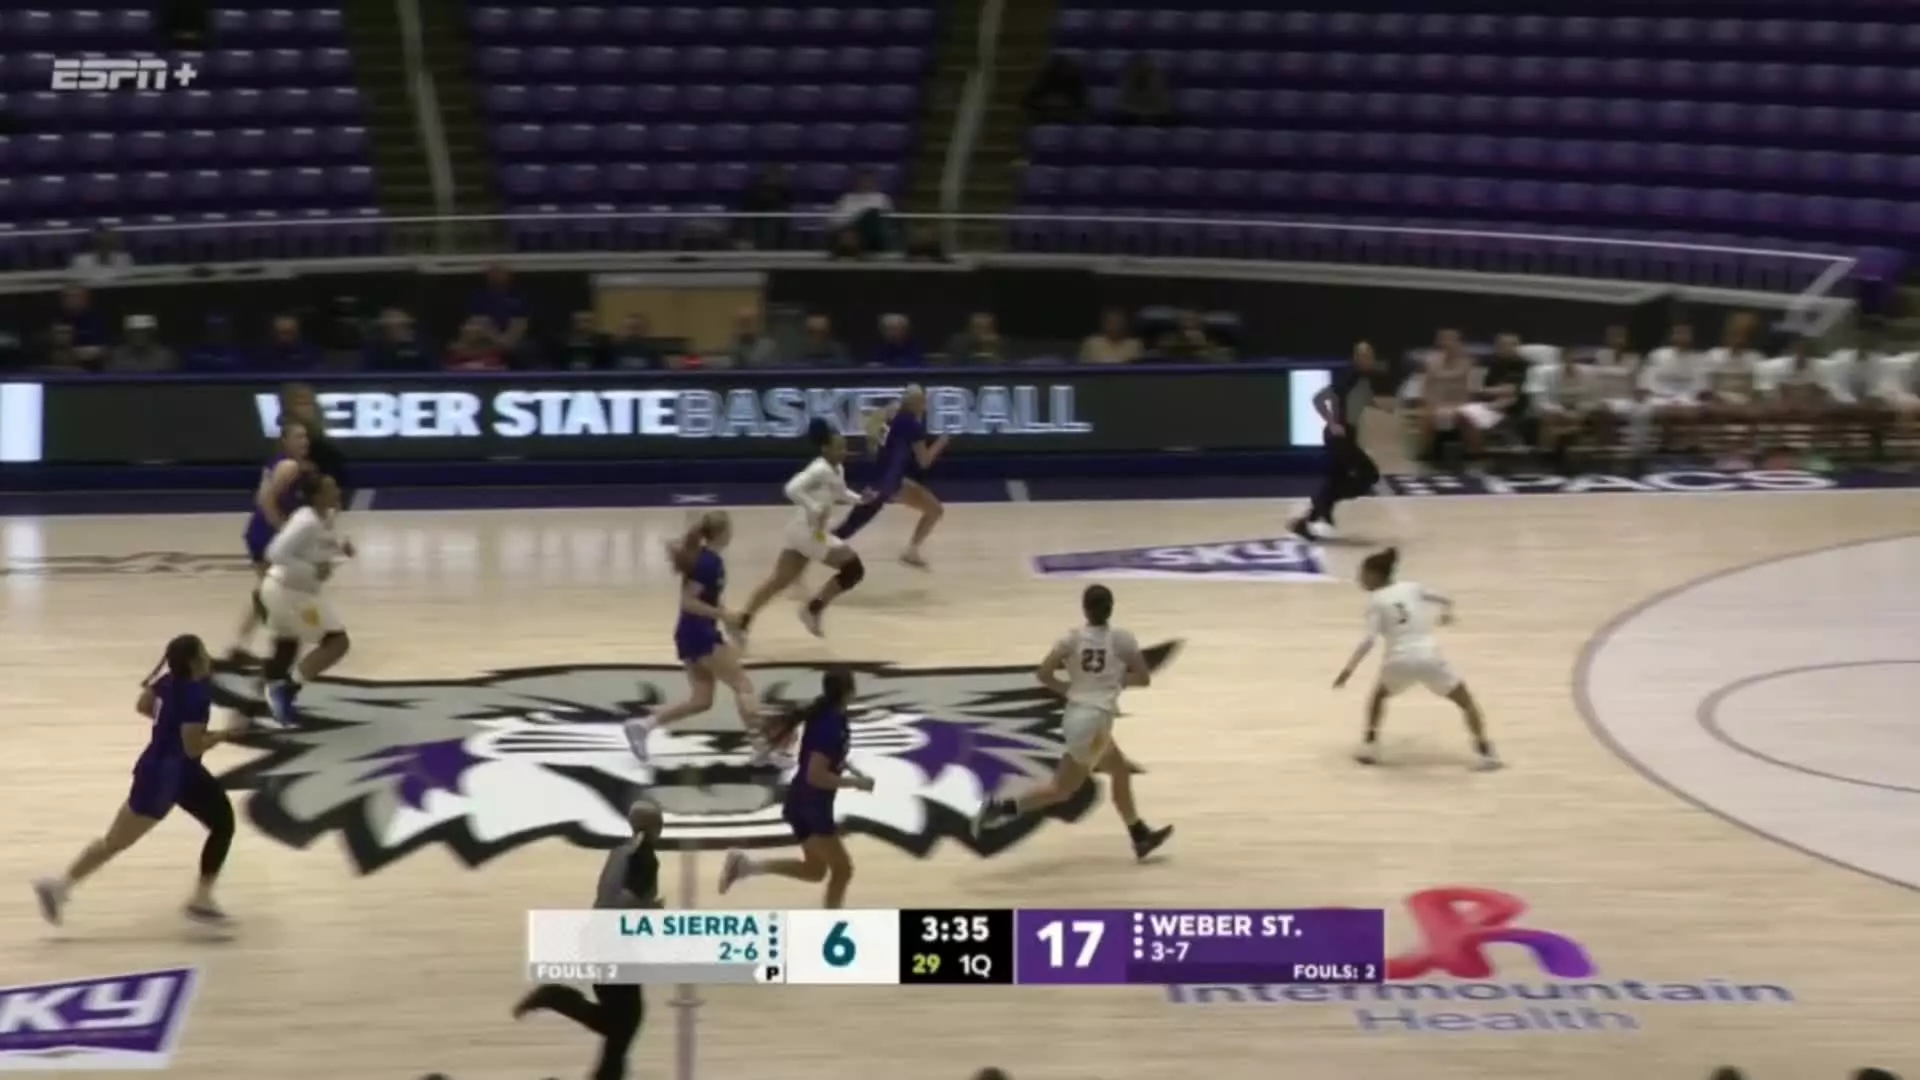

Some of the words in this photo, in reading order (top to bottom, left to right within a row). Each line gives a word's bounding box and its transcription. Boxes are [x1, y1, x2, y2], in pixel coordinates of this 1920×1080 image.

[492, 390, 681, 438] STATE
[675, 385, 1094, 438] BASKEBALL
[1081, 648, 1106, 673] 23
[1166, 978, 1793, 1003] Intermountain
[1355, 1006, 1640, 1031] Health
